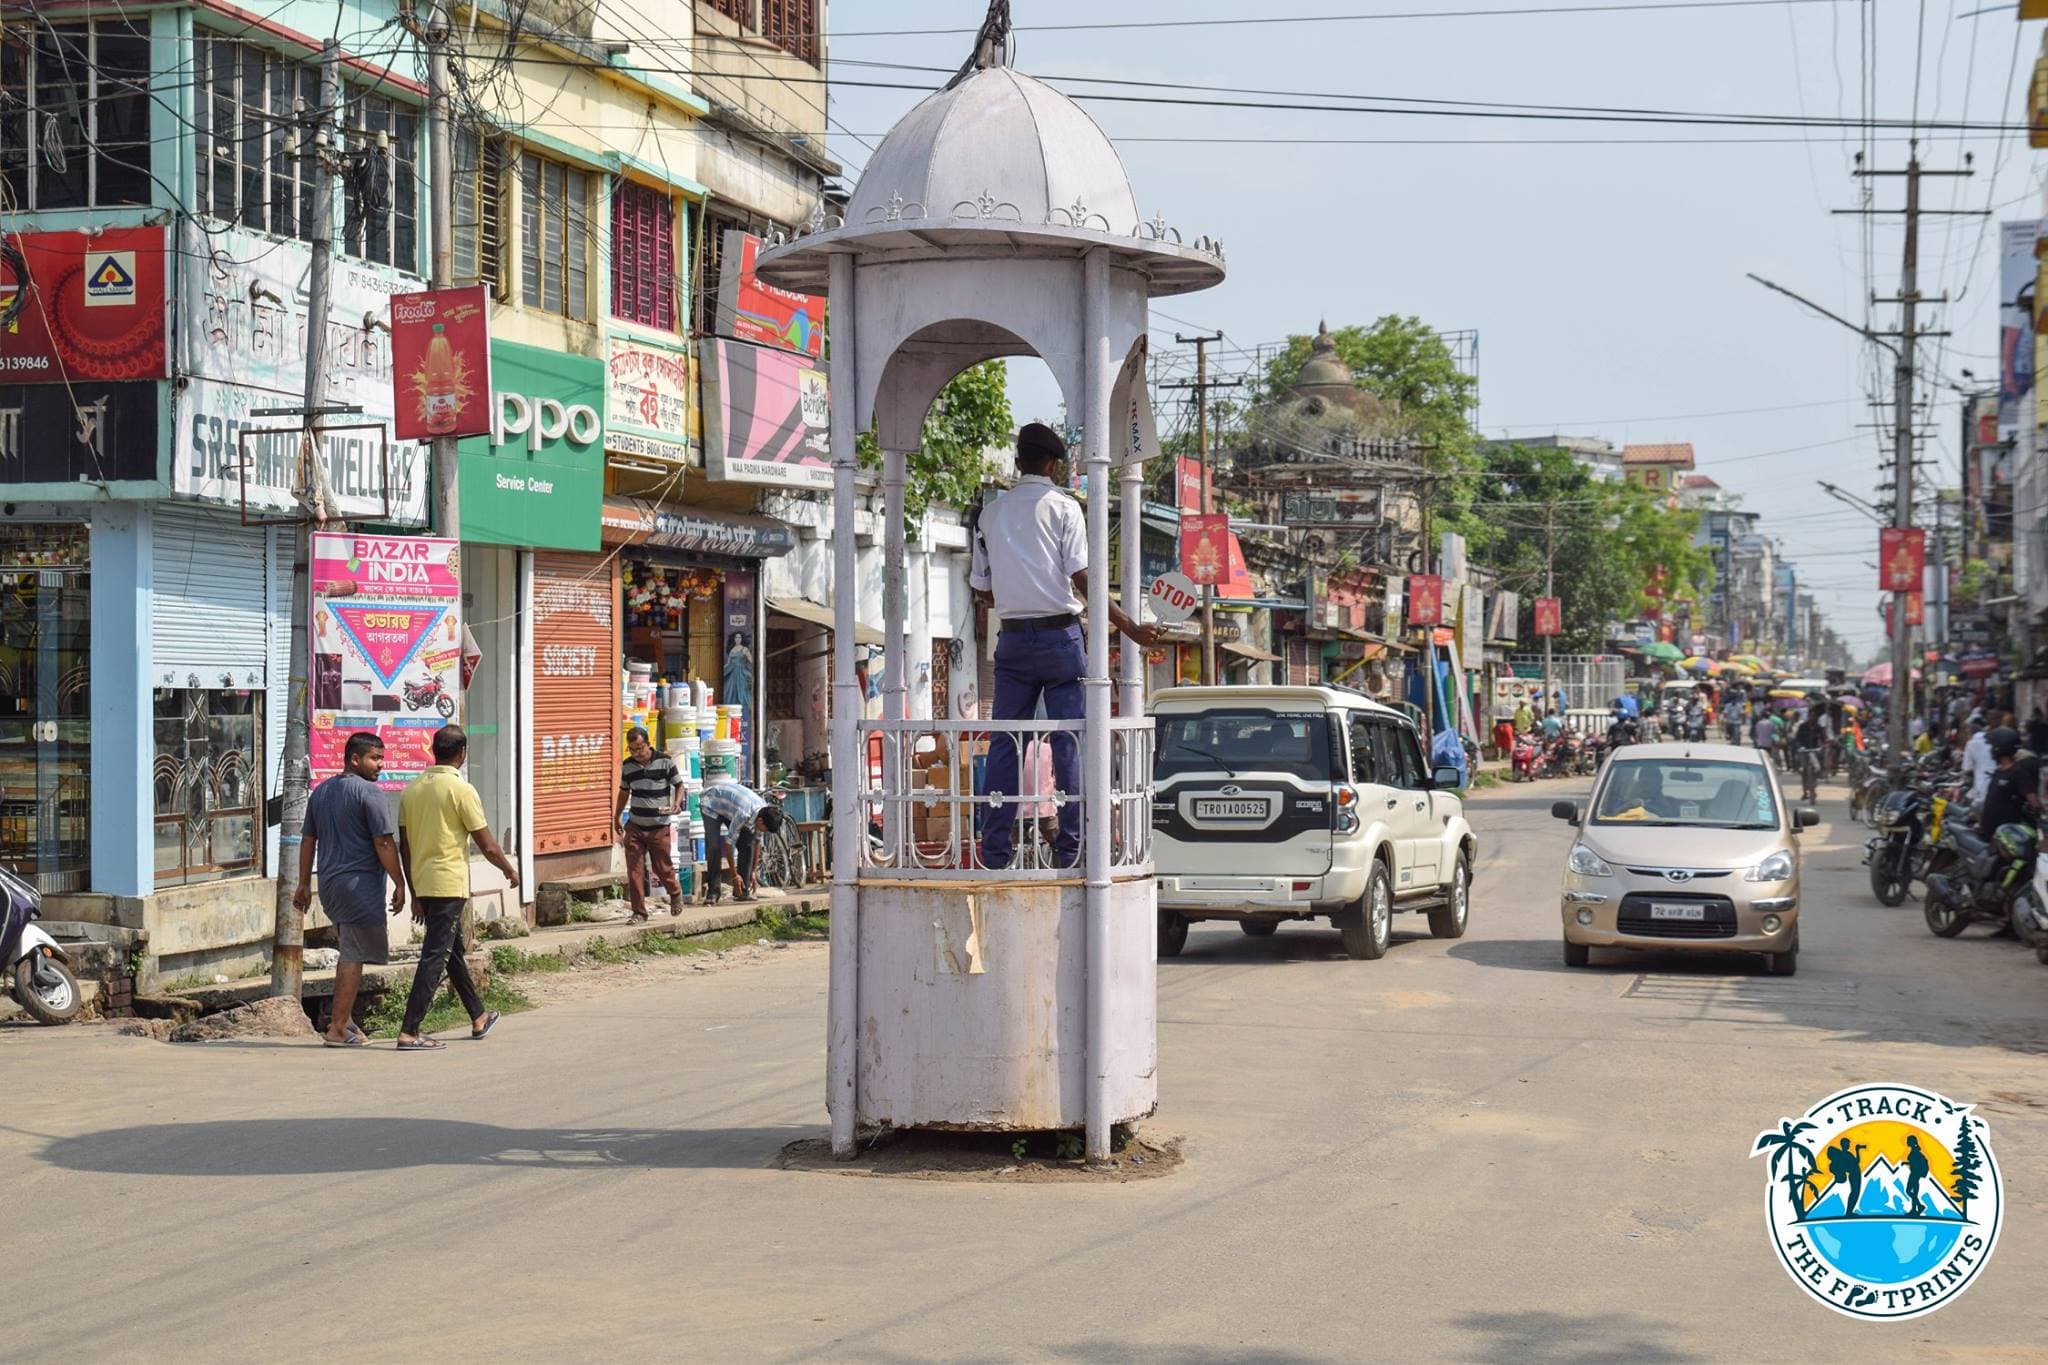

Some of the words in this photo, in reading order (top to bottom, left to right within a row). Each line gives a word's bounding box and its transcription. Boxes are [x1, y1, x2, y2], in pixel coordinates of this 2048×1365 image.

[490, 391, 600, 451] ppo
[192, 414, 252, 484] SREE
[612, 435, 645, 454] STUDENTS
[646, 440, 660, 456] BOOK
[662, 444, 684, 460] SOCIETY
[496, 473, 525, 491] Service
[528, 477, 553, 494] Center
[354, 540, 430, 561] BAZAR
[1152, 579, 1195, 610] STOP
[366, 632, 409, 644] আগরতলা
[542, 645, 598, 676] SOCIETY
